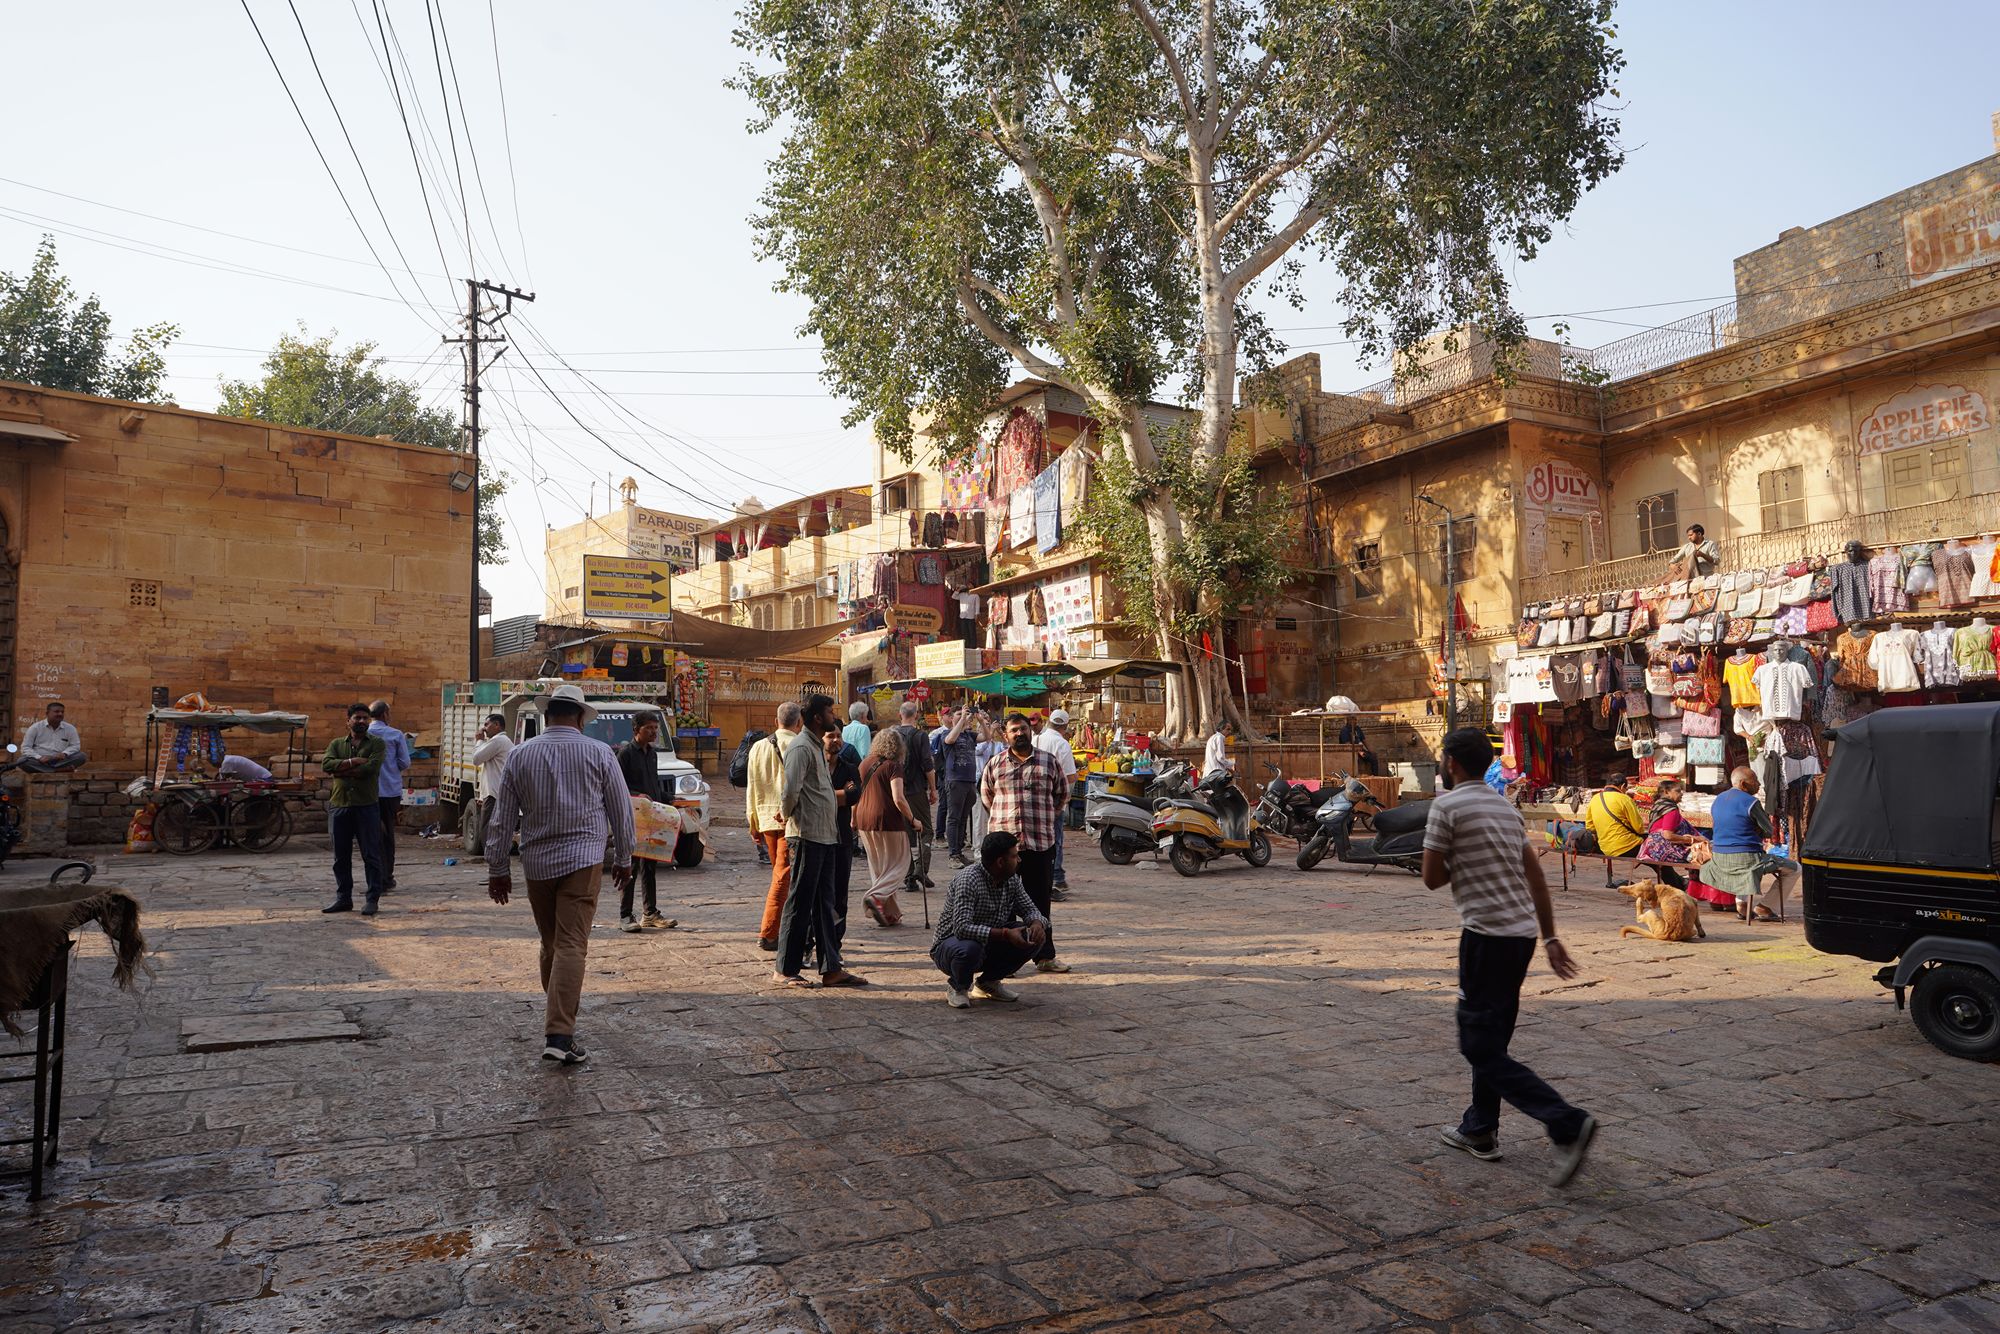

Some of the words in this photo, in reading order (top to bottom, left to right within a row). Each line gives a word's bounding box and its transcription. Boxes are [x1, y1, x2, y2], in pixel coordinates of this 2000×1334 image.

[1868, 404, 1935, 435] APPLE
[1938, 394, 1974, 418] PIE
[638, 513, 703, 533] PARADISE
[663, 544, 694, 560] PAR
